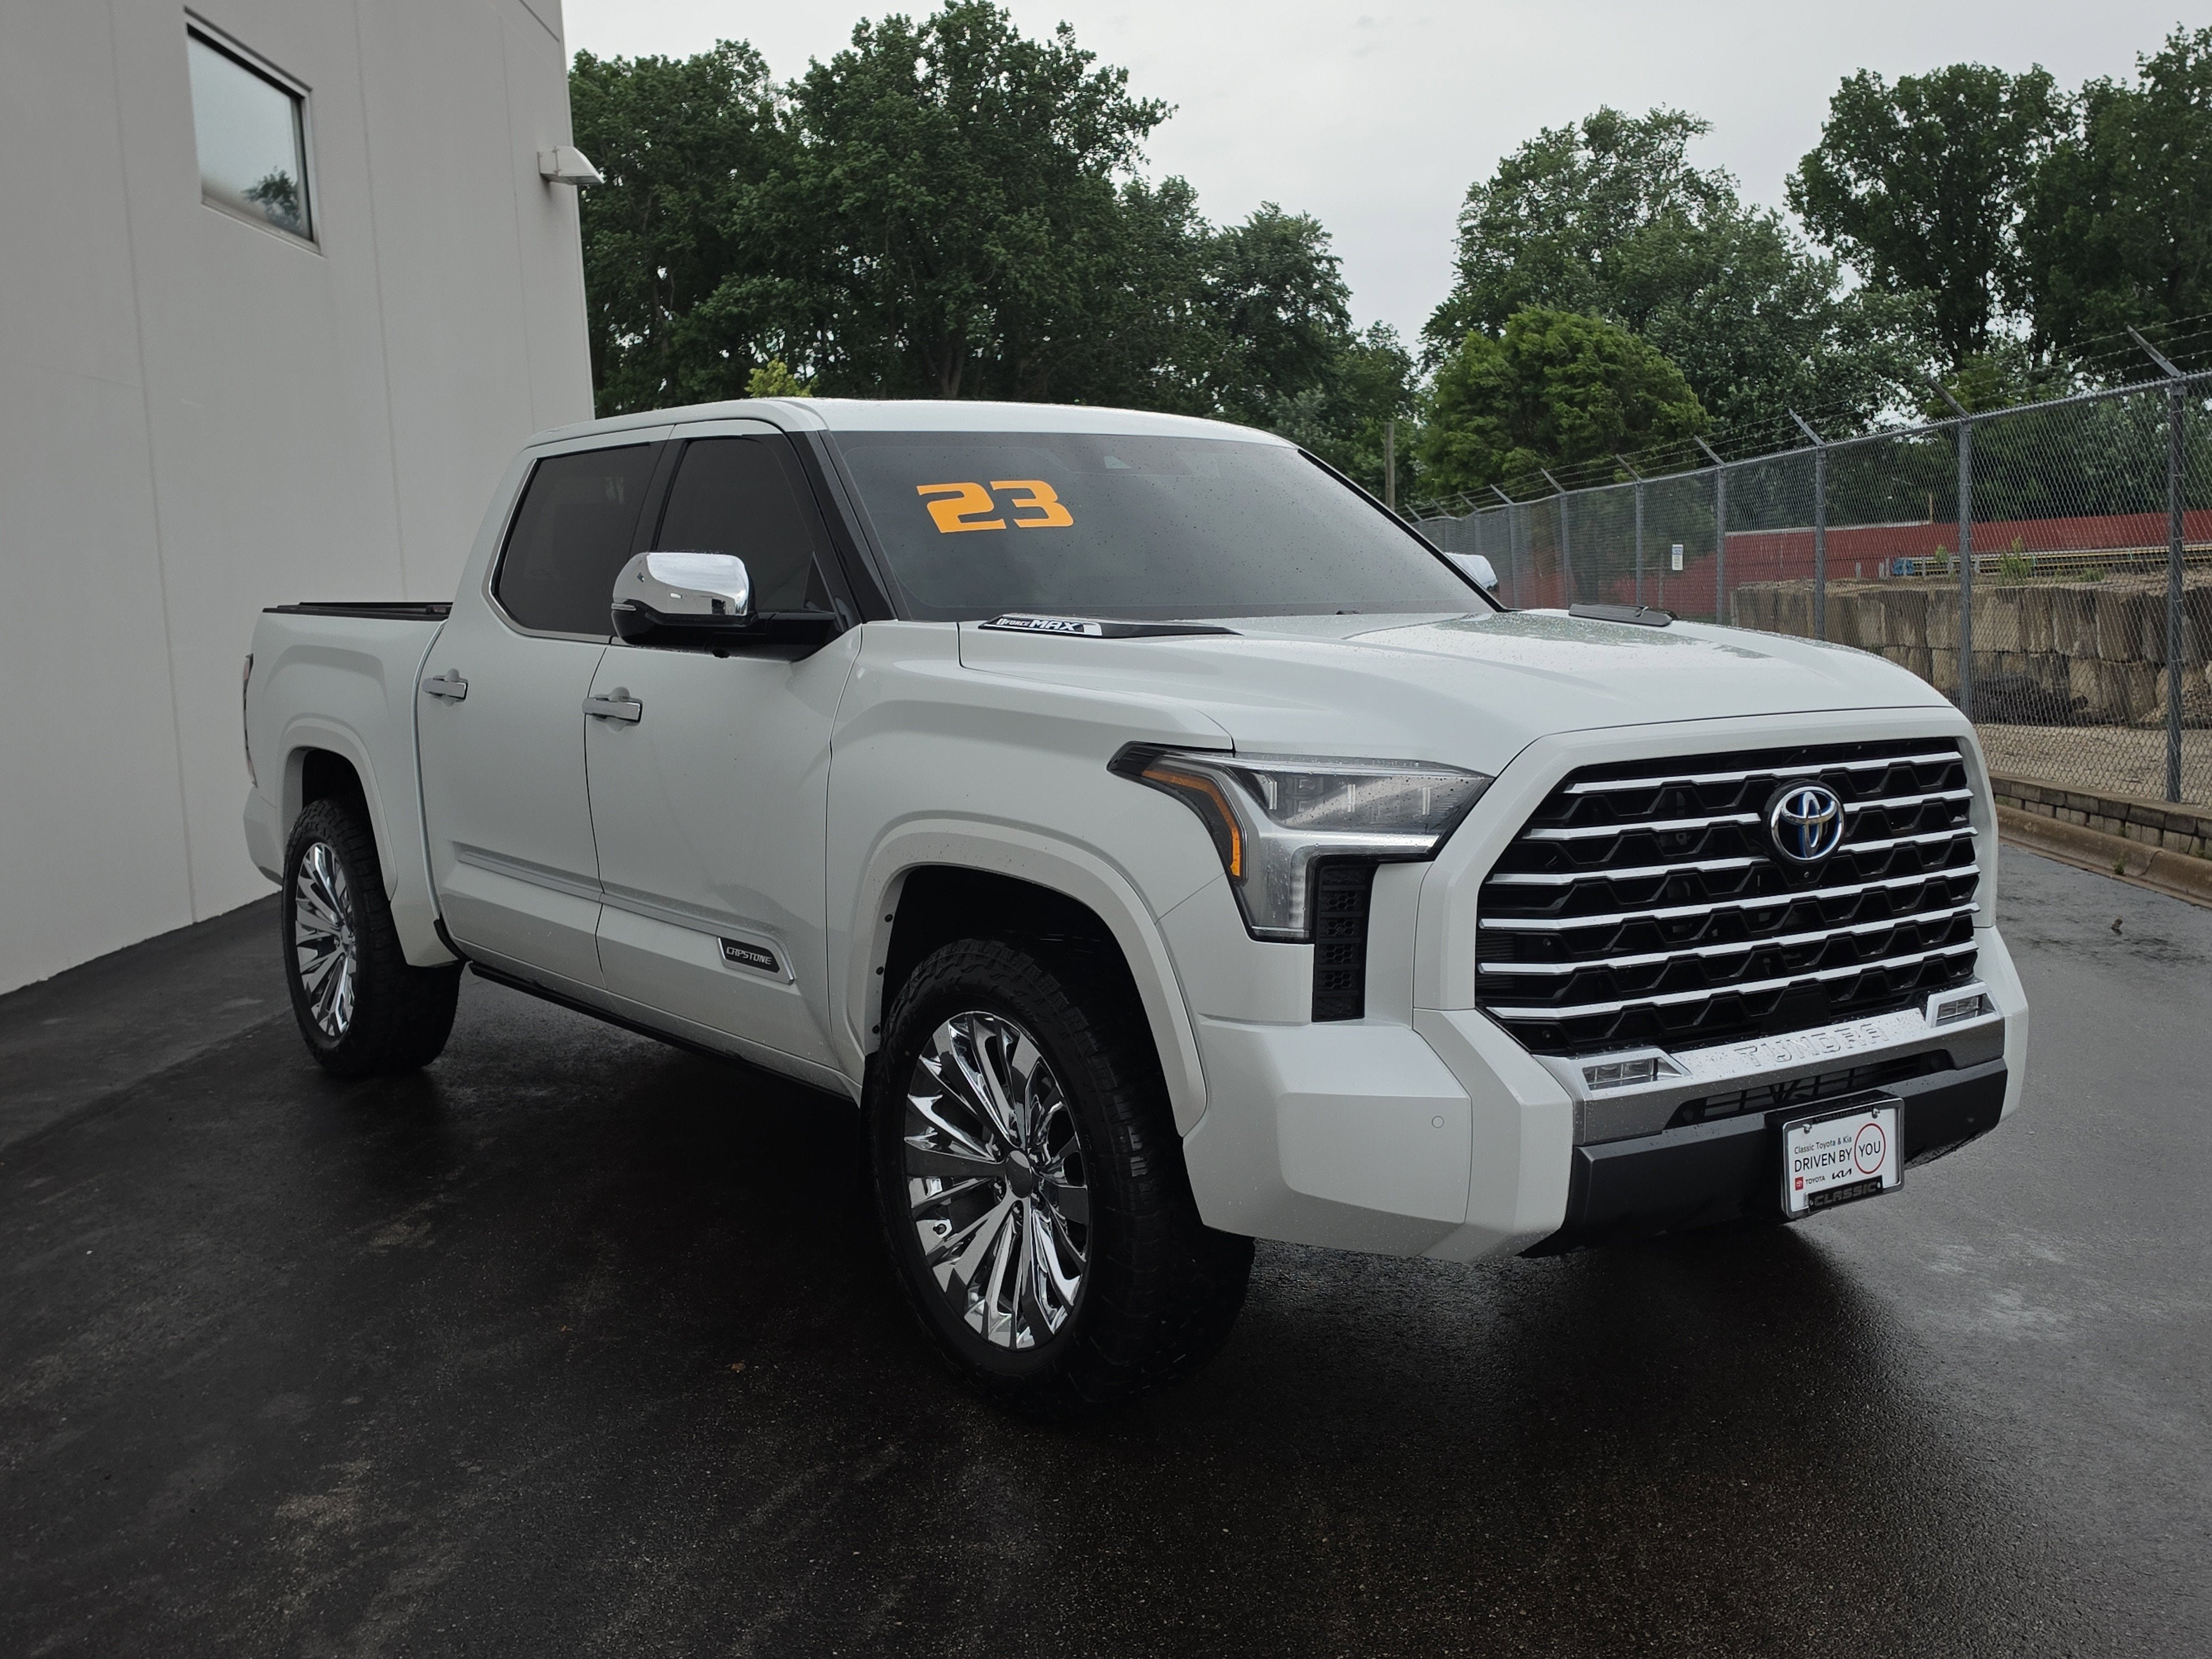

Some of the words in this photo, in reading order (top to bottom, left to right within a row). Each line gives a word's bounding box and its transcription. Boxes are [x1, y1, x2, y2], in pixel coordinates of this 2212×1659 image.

[916, 480, 1074, 533] 23
[1029, 619, 1080, 631] MAX
[726, 947, 772, 964] CAPSTONE
[1734, 1023, 1889, 1067] TUNDRA
[1795, 1143, 1814, 1154] Classic
[1816, 1140, 1836, 1150] Toyota
[1843, 1135, 1852, 1143] Kia
[1795, 1151, 1836, 1172] DRIVEN
[1839, 1147, 1852, 1162] BY
[1859, 1141, 1881, 1157] YOU
[1805, 1175, 1825, 1185] TOYOTA
[1814, 1182, 1876, 1206] CLASSIC
